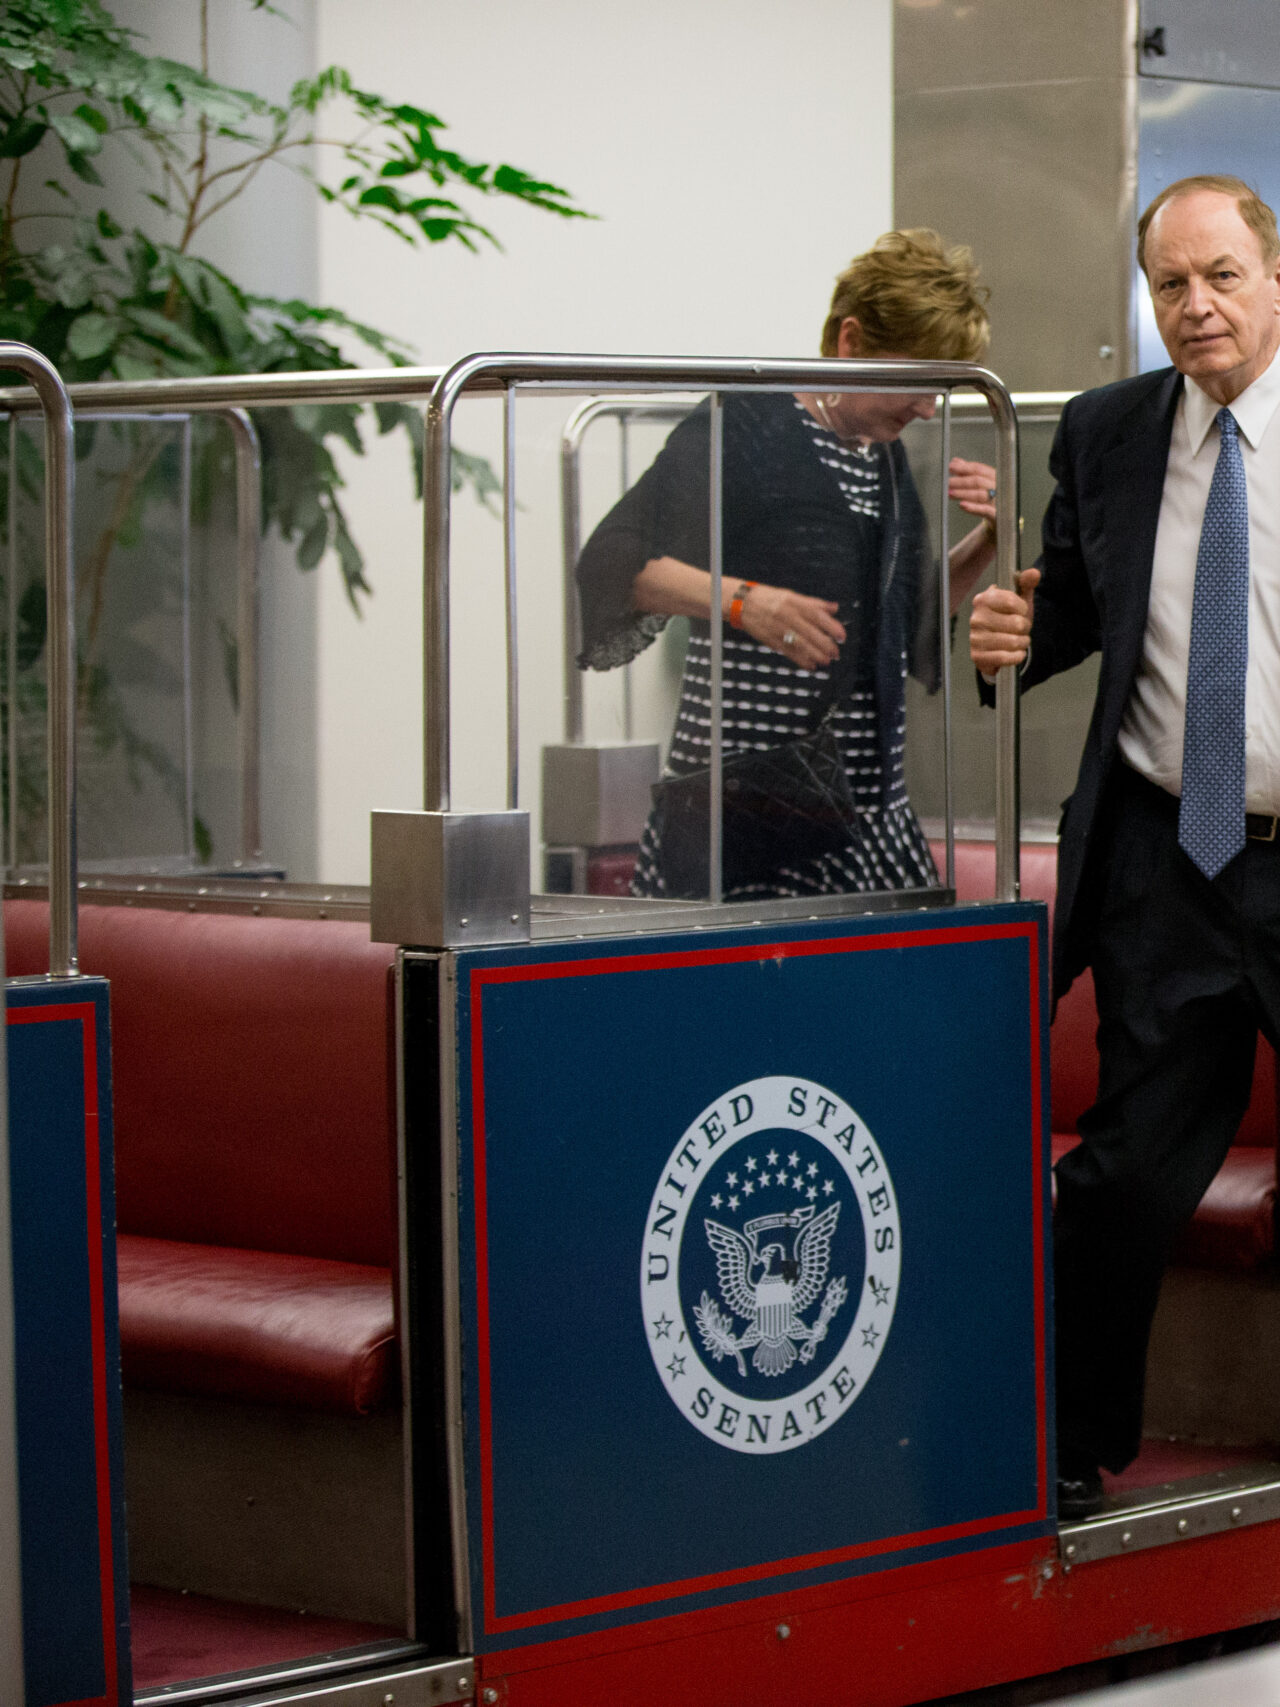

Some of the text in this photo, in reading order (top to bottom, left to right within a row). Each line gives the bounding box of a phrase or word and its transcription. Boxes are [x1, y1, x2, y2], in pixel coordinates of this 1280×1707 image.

[648, 1086, 894, 1286] UNITED STATES
[691, 1366, 856, 1443] SENATE
